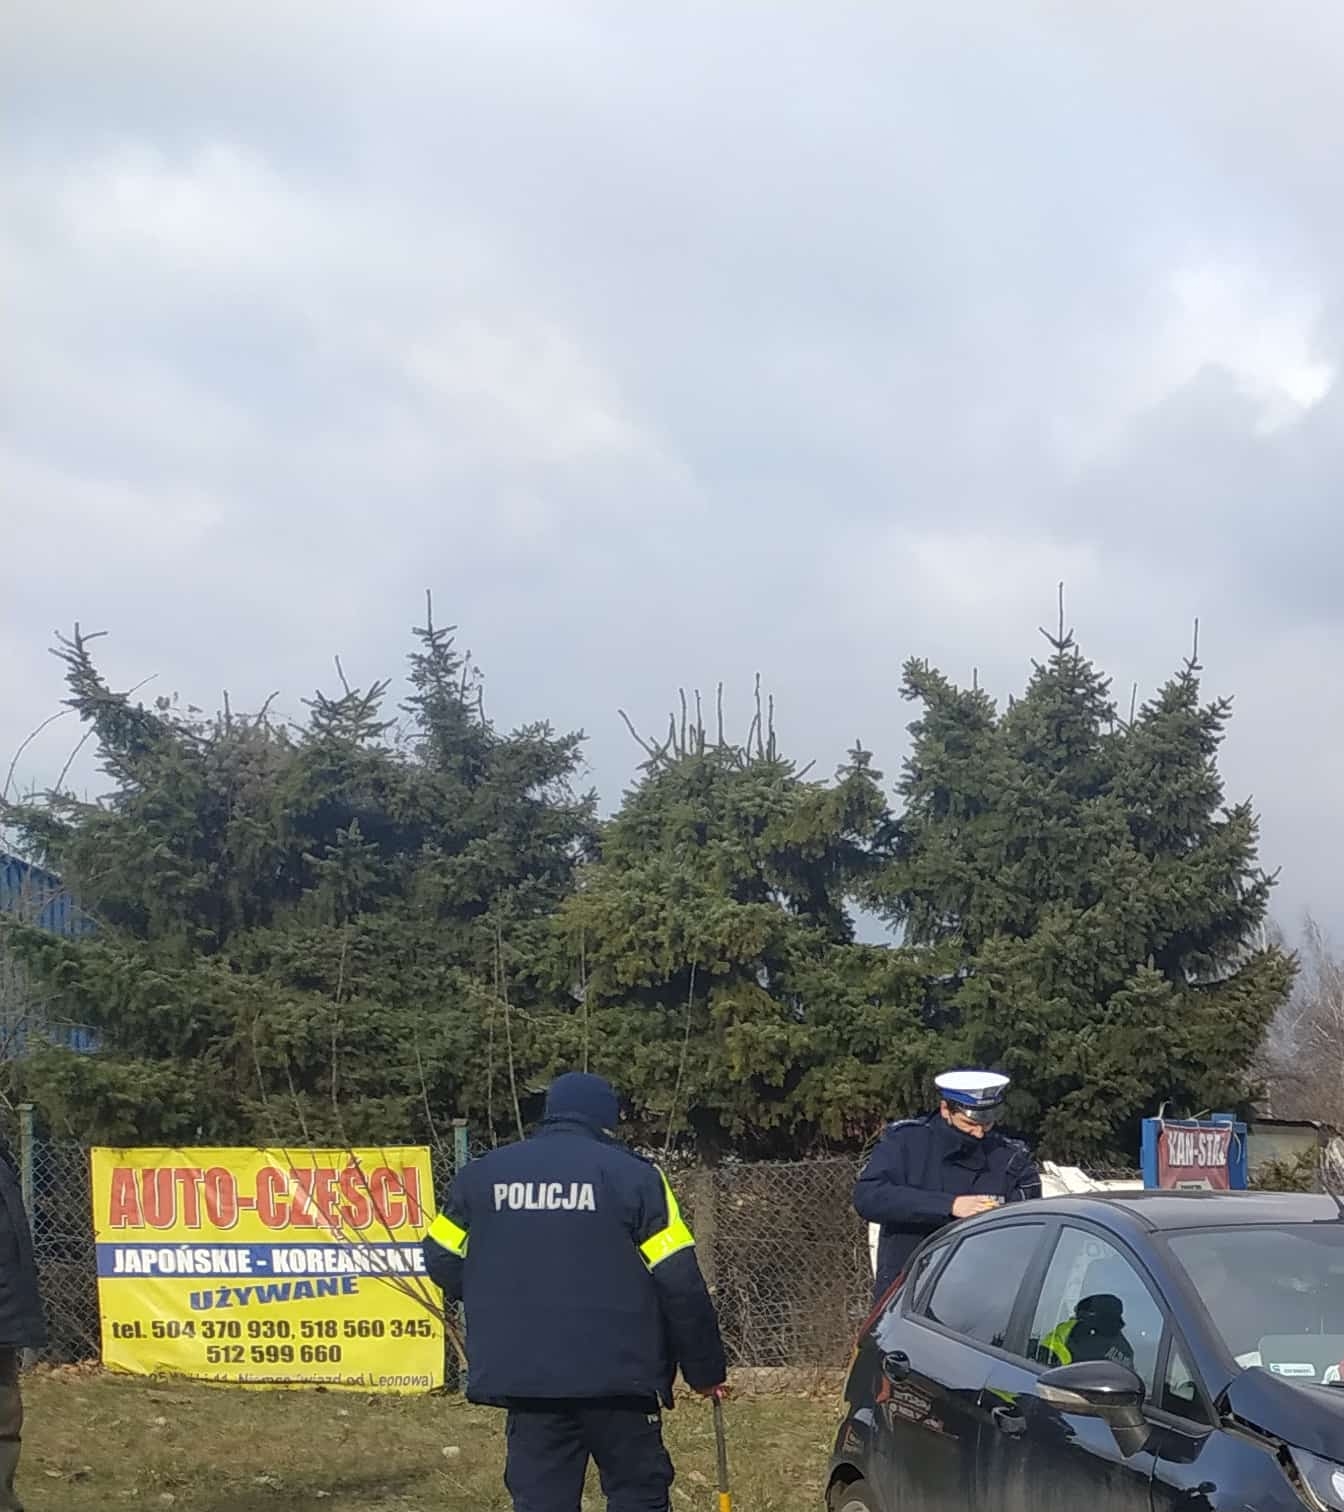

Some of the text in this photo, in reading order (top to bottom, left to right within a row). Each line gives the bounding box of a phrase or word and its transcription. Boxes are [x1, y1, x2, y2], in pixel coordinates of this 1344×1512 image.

[109, 1157, 423, 1238] AUTO-CZĘŚCI
[493, 1182, 596, 1211] POLICJA
[113, 1245, 252, 1273] JAPOŃSKIE
[273, 1244, 426, 1273] KOREAŃSKIE
[189, 1275, 360, 1311] UŻYWANE
[112, 1319, 436, 1341] tel. 504 370 930, 518 560 345,
[207, 1345, 342, 1363] 512 599 660
[346, 1372, 364, 1386] od
[369, 1372, 434, 1387] Leonowa)
